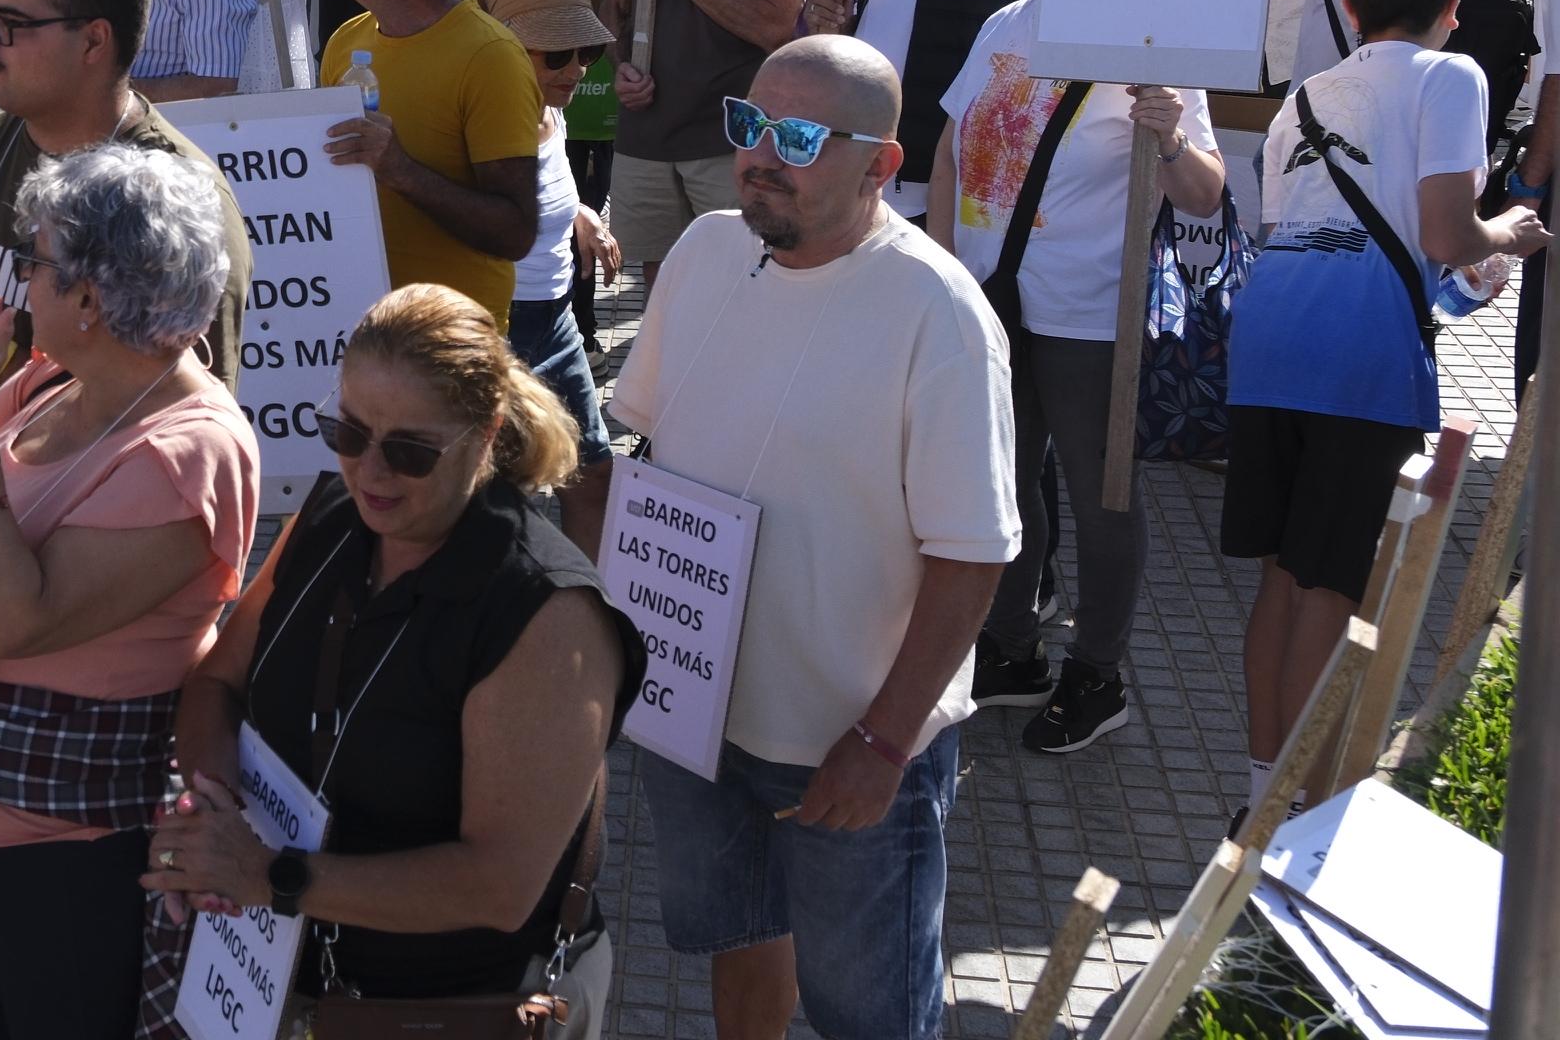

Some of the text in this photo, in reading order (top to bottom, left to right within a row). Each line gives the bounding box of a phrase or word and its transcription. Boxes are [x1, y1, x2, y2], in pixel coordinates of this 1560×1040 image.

[643, 496, 717, 543] BARRIO
[618, 531, 730, 596] LAS TORRES
[628, 581, 704, 632] UNIDOS
[672, 646, 714, 681] MÁS
[252, 771, 300, 842] BARRIO
[206, 911, 275, 1007] SOMOS MÁS
[205, 963, 244, 1034] LPGC
